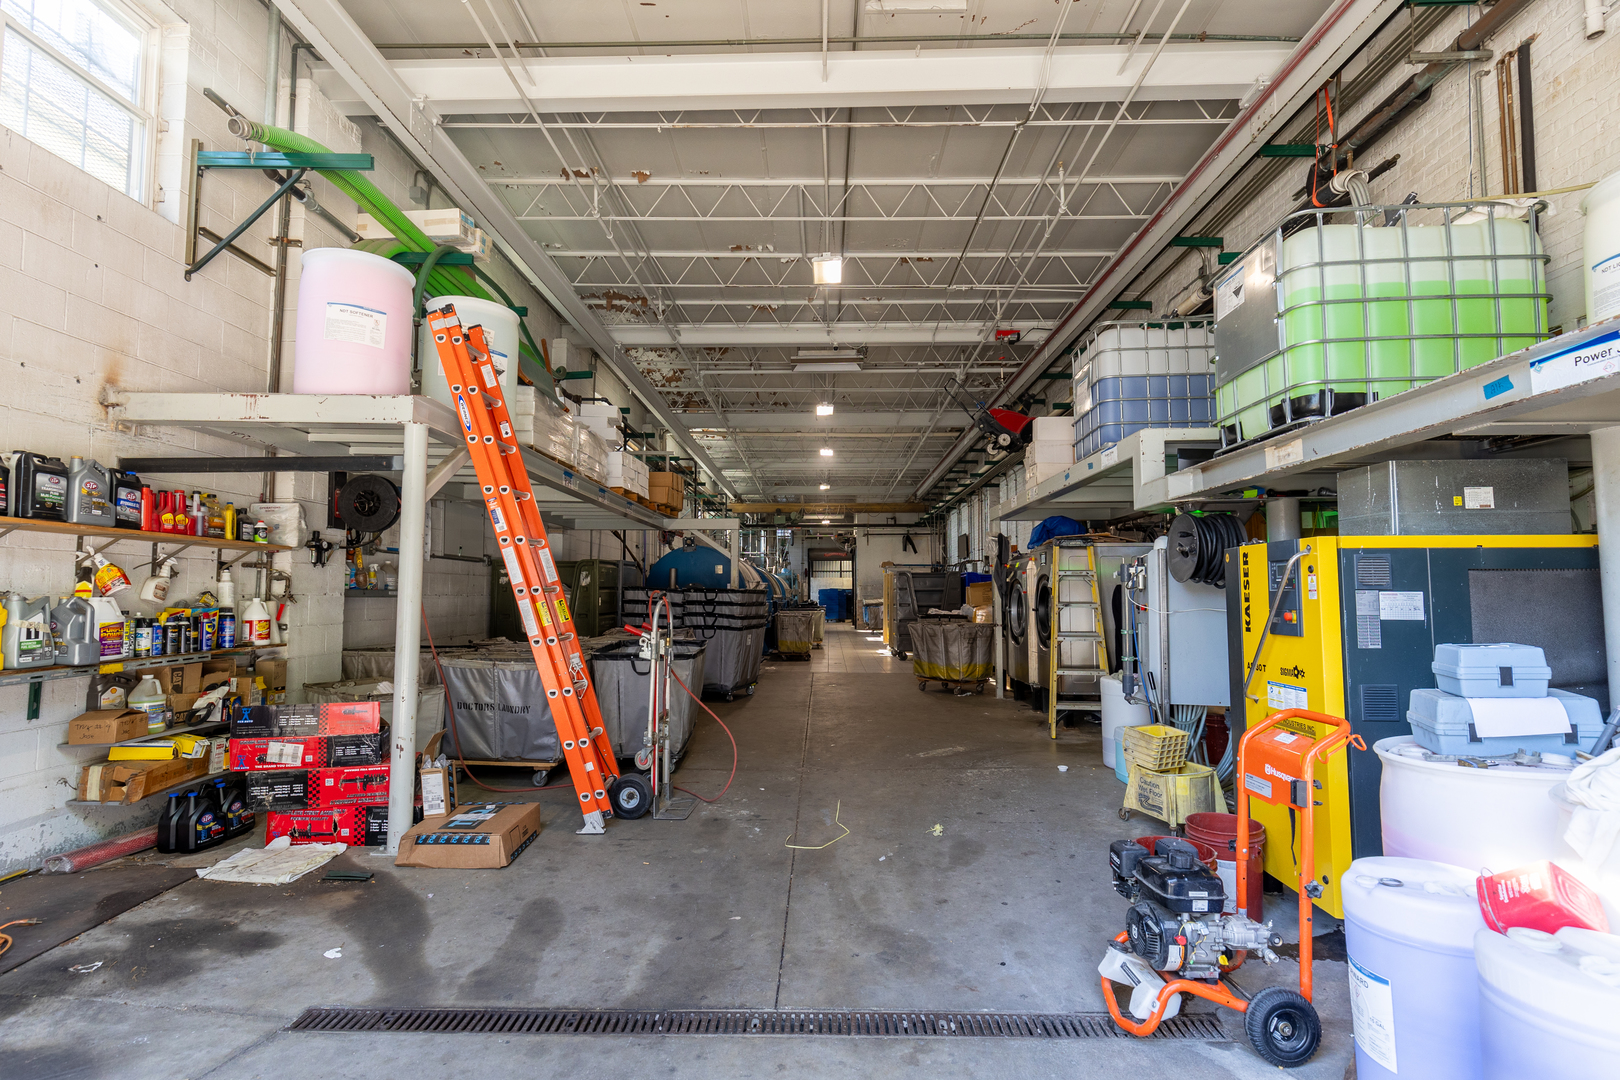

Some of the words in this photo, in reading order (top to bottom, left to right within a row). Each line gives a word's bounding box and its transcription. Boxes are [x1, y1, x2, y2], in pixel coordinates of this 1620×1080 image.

[349, 309, 374, 318] SOFTENER
[1574, 347, 1613, 367] Power
[84, 481, 98, 490] STP
[125, 492, 137, 501] STP
[1243, 551, 1252, 633] KAESER
[173, 671, 183, 687] CAT
[457, 701, 495, 712] DOCTORS
[498, 703, 531, 714] LAUNDRY
[1138, 784, 1149, 793] Wet
[1149, 788, 1163, 798] Floor
